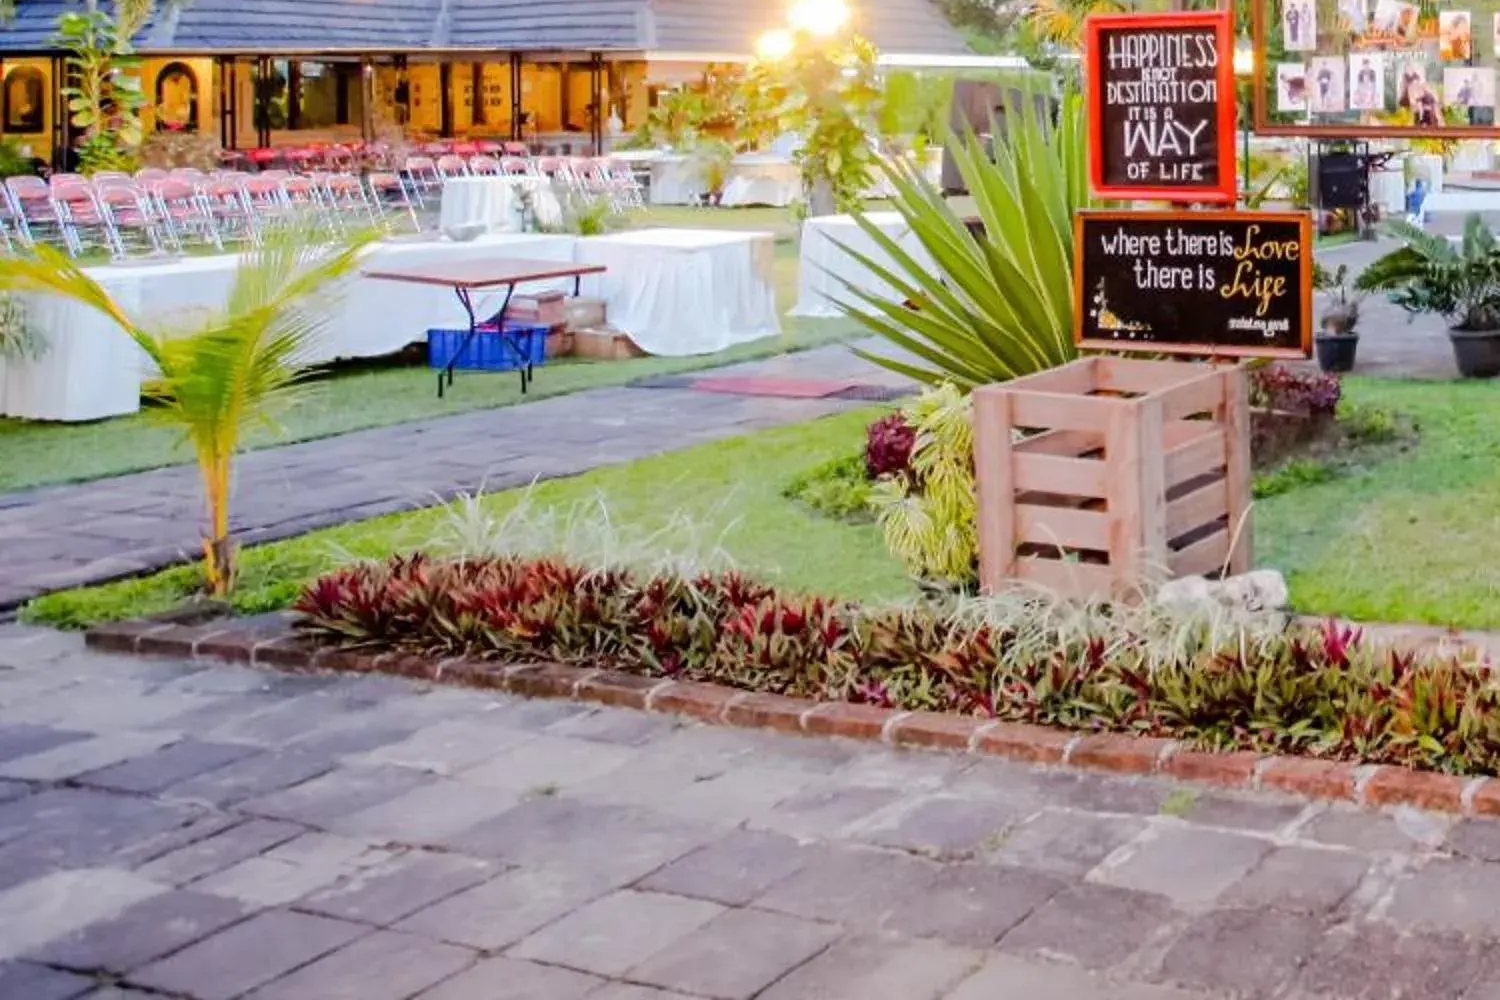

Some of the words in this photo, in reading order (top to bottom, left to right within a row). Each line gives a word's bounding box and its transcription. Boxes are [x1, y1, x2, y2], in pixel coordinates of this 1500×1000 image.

[1108, 33, 1218, 69] HAPPINESS
[1141, 67, 1151, 81] IS
[1107, 80, 1218, 105] DESTINATION
[1128, 106, 1141, 121] IT
[1143, 106, 1158, 121] IS
[1163, 106, 1174, 121] A
[1123, 119, 1209, 157] WAY
[1127, 161, 1152, 180] OF
[1159, 162, 1205, 181] LIFE
[1101, 227, 1161, 256] where
[1165, 228, 1218, 257] there
[1219, 230, 1234, 257] is
[1233, 224, 1300, 261] Love
[1134, 258, 1194, 290] there
[1199, 264, 1216, 291] is
[1219, 260, 1287, 317] Life
